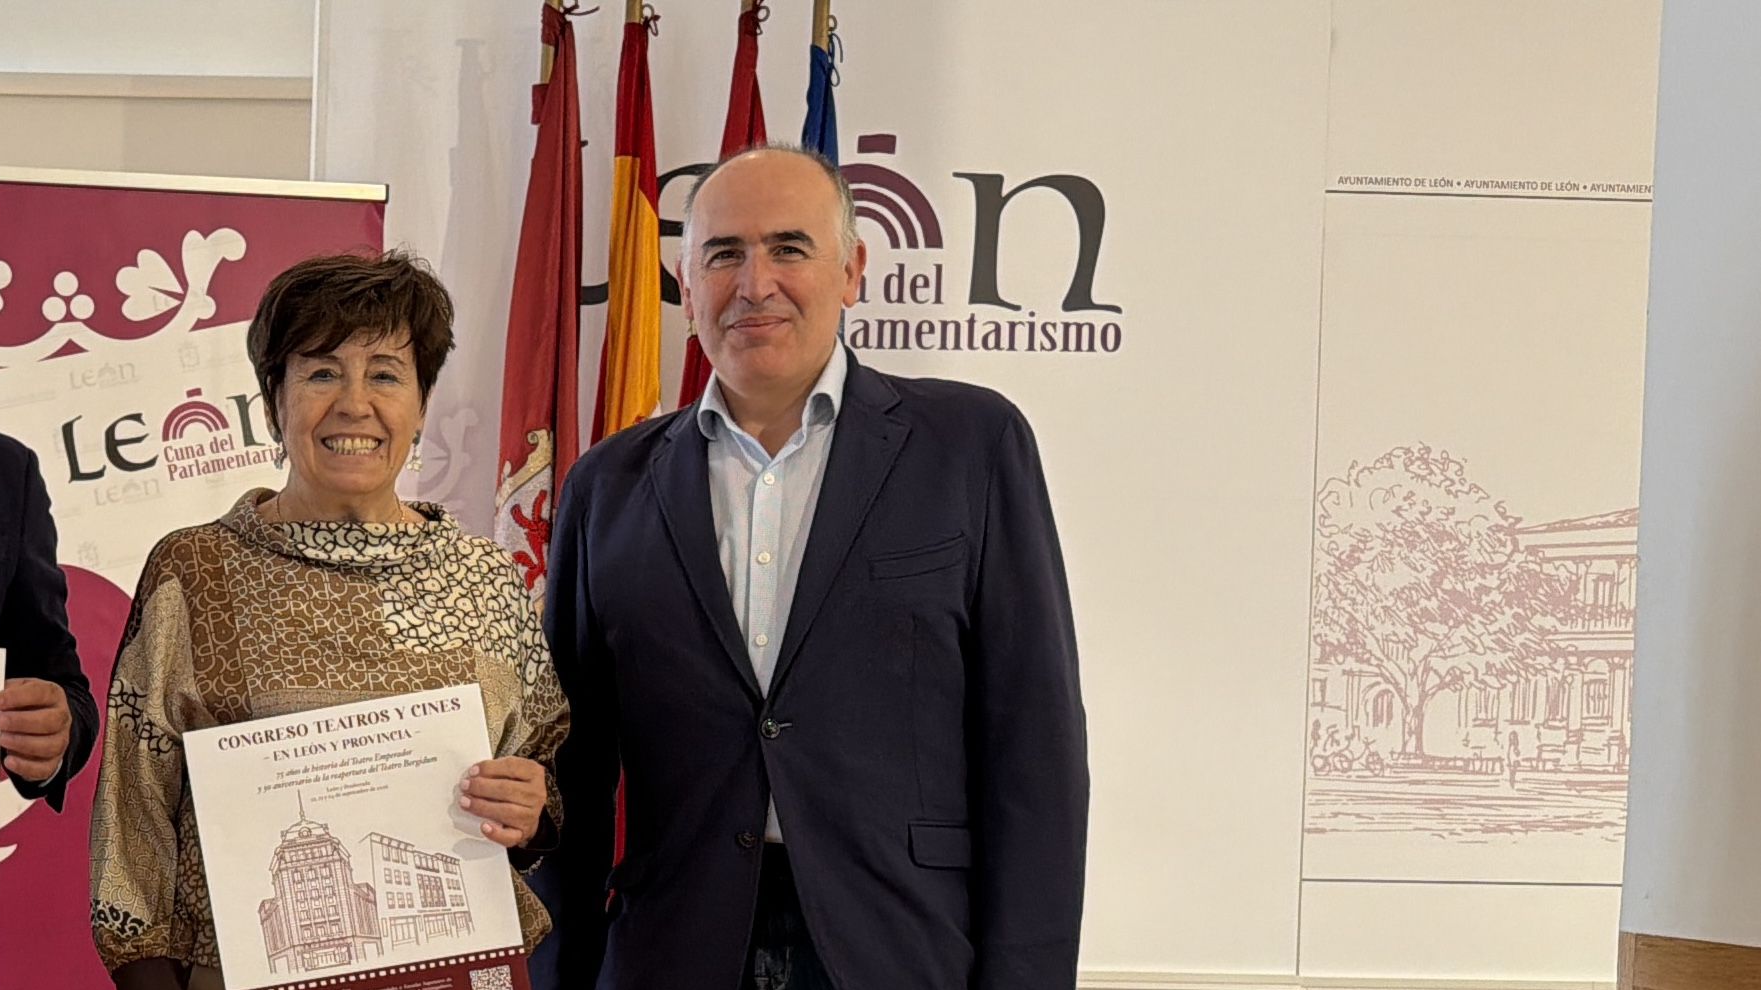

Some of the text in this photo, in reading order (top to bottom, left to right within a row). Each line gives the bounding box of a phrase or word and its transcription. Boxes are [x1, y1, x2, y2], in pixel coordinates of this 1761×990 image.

[1337, 175, 1412, 187] AYUNTAMIENTO
[1414, 177, 1427, 187] DE
[1429, 176, 1454, 188] LEÓN
[1463, 179, 1538, 191] AYUNTAMIENTO
[1540, 182, 1552, 192] DE
[1555, 180, 1580, 192] LEÓN
[883, 263, 944, 304] del
[840, 309, 1122, 353] lamentarismo
[163, 433, 235, 463] Cuna del
[167, 444, 279, 481] Parlamentari
[217, 697, 462, 752] CONGRESO TEATROS Y CINES
[273, 728, 413, 762] EN LEÓN Y PROVINCIA
[339, 758, 350, 769] del
[351, 756, 373, 767] Teatro
[374, 749, 413, 763] Emperador
[367, 764, 379, 774] del
[379, 761, 402, 772] Teatro
